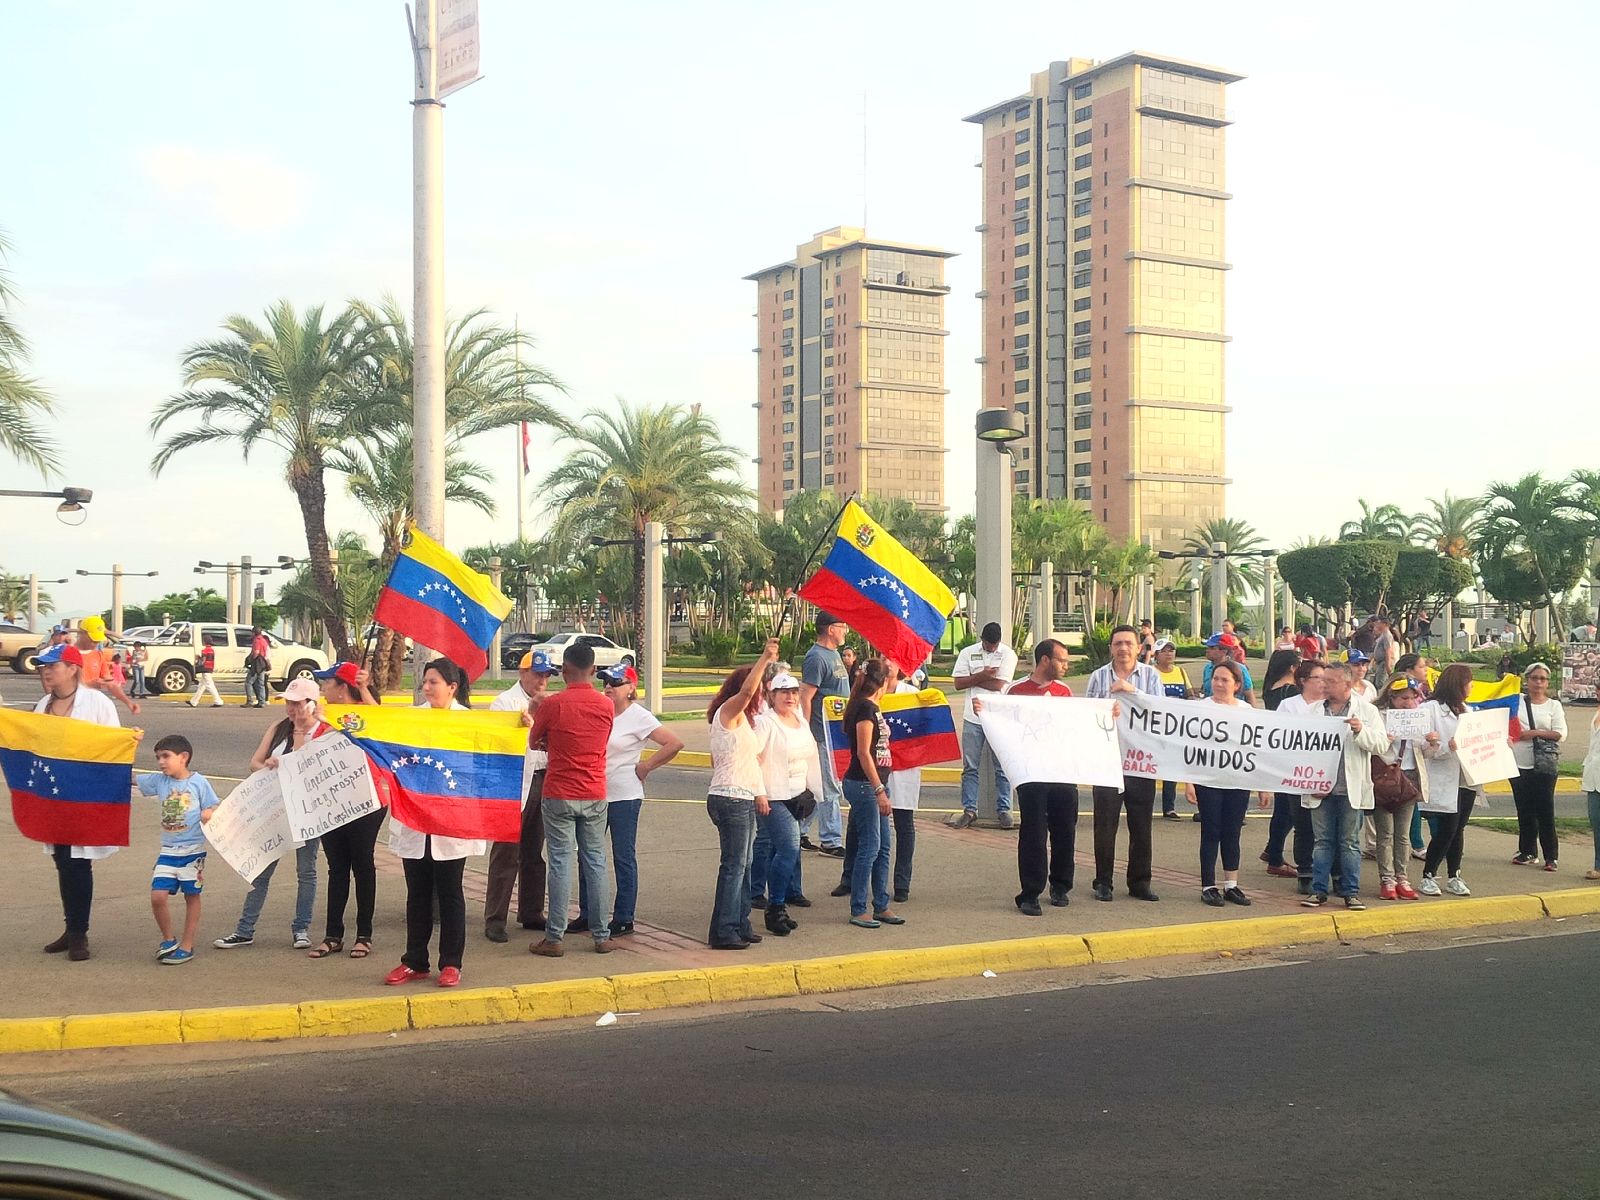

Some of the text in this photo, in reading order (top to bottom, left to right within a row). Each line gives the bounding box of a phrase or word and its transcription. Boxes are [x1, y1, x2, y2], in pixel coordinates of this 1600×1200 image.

[1129, 706, 1341, 751] MEDICOS DE GUAYANA
[315, 749, 328, 767] por
[331, 739, 352, 751] una
[1183, 745, 1257, 773] UNIDOS
[1123, 760, 1158, 774] BALAS
[1294, 766, 1314, 779] NO
[1281, 778, 1332, 792] MUERTES
[301, 827, 315, 839] no
[261, 833, 284, 854] VZLA
